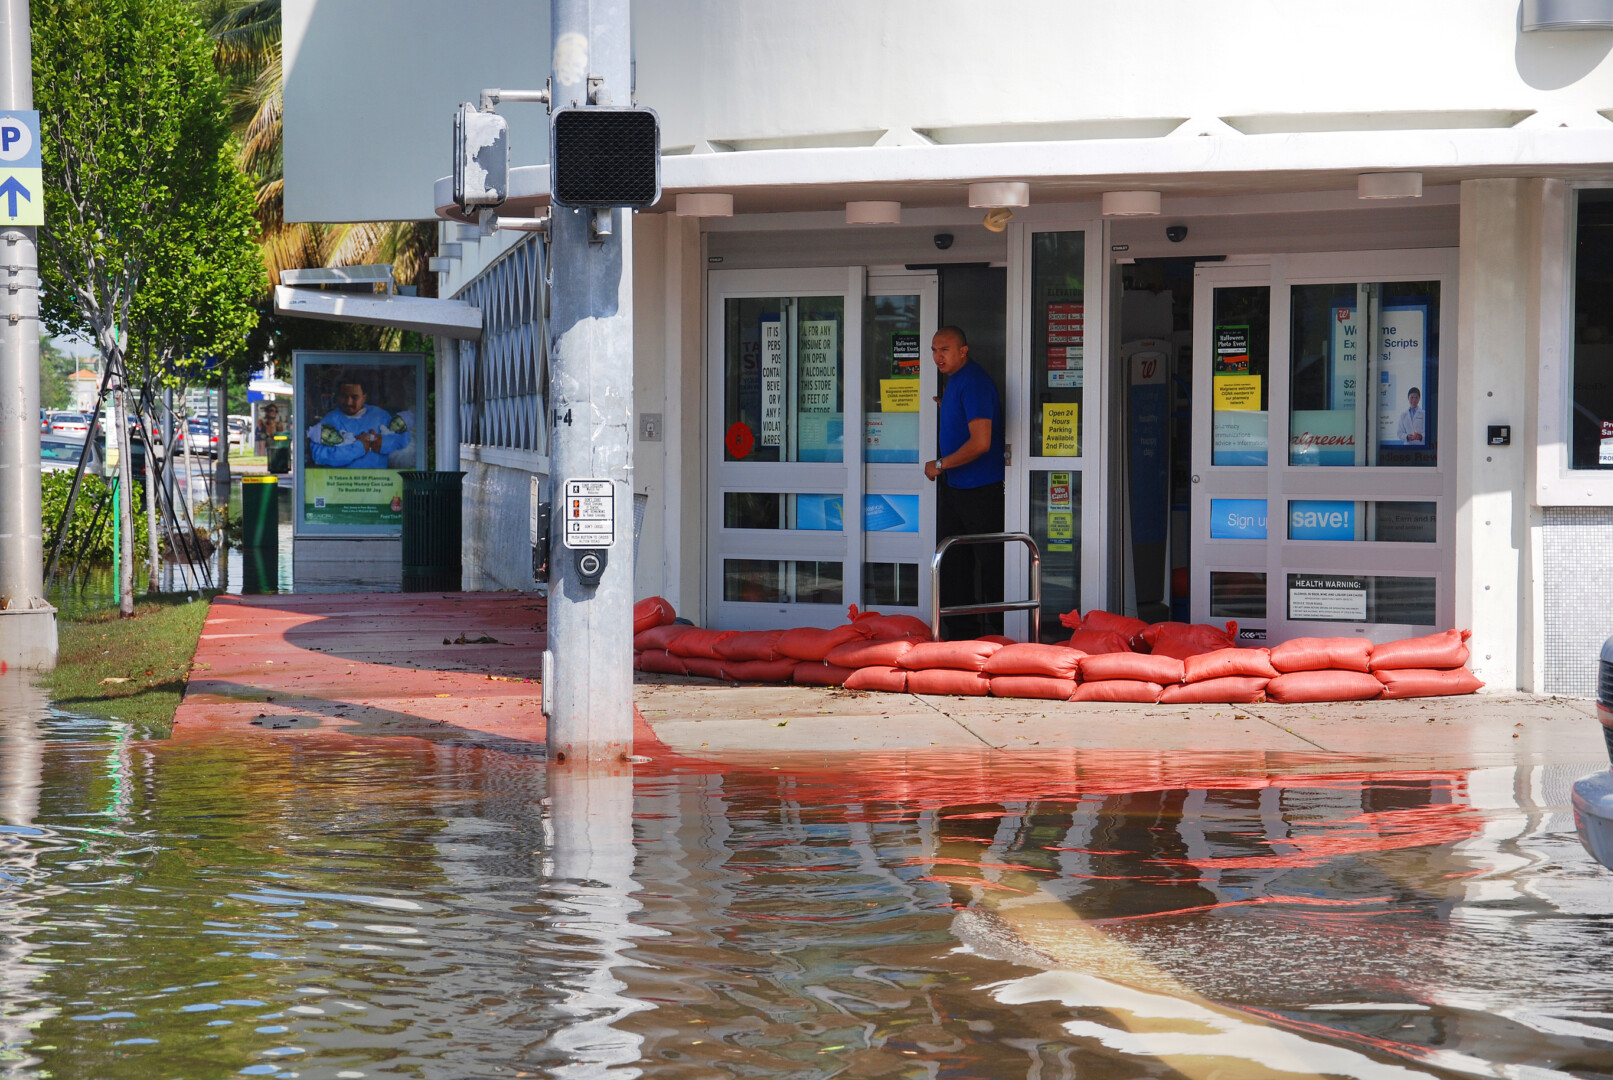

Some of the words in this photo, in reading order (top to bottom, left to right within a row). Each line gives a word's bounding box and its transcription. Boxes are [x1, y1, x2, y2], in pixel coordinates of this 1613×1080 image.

[2, 127, 20, 151] P
[766, 326, 771, 337] IT
[773, 326, 779, 337] IS
[808, 325, 818, 336] FOR
[820, 325, 831, 336] ANY
[823, 339, 831, 350] OR
[1384, 338, 1419, 349] Scripts
[811, 353, 827, 364] OPEN
[805, 366, 836, 377] ALCOHOLIC
[1141, 359, 1157, 379] W
[814, 379, 831, 391] STORE
[768, 394, 777, 404] OR
[807, 394, 821, 404] FEET
[822, 393, 829, 404] OF
[766, 408, 775, 418] ANY
[736, 435, 743, 446] R
[1227, 513, 1254, 529] Sign
[1291, 511, 1348, 529] save!
[1295, 580, 1324, 588] HEALTH
[1324, 580, 1361, 589] WARNING:
